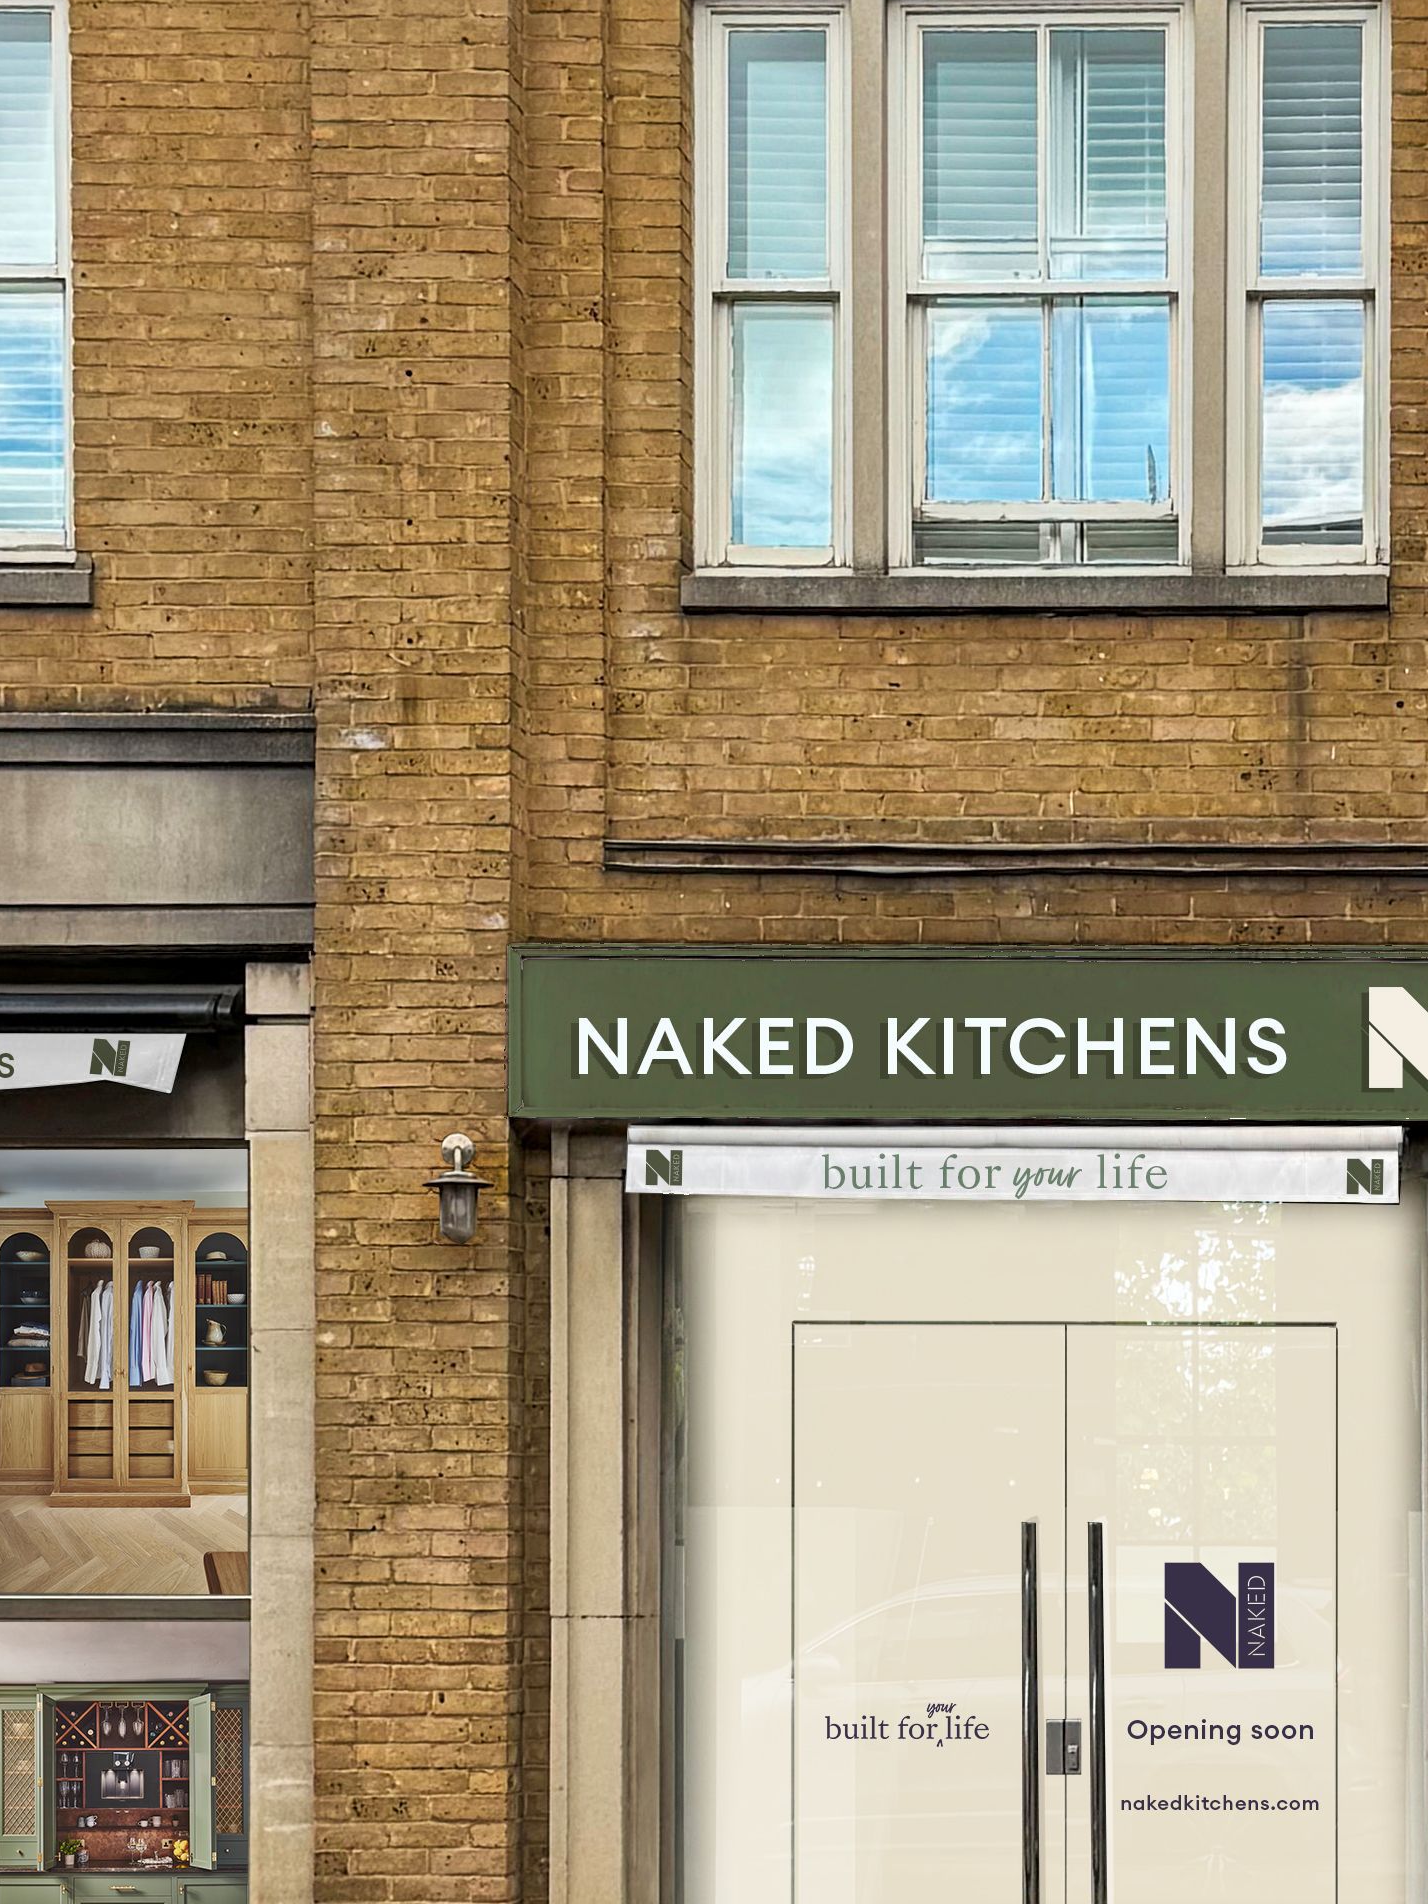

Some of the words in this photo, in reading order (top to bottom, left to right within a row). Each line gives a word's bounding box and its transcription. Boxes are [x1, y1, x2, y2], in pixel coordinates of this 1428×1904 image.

[117, 1045, 128, 1074] NAKED
[577, 1016, 855, 1076] NAKED
[886, 1016, 1288, 1076] KITCHENS
[673, 1153, 682, 1182] NAKED
[822, 1152, 922, 1190] built
[938, 1152, 1001, 1190] for
[1012, 1159, 1083, 1199] your
[1096, 1152, 1169, 1190] life
[1373, 1162, 1382, 1191] NAKED
[1247, 1574, 1266, 1656] NAKED
[926, 1701, 957, 1718] your
[824, 1714, 890, 1740] built
[897, 1714, 939, 1740] for
[945, 1714, 990, 1740] life
[1126, 1718, 1241, 1746] Opening
[1250, 1723, 1314, 1741] soon
[1120, 1794, 1320, 1811] nakedkitchens.com
